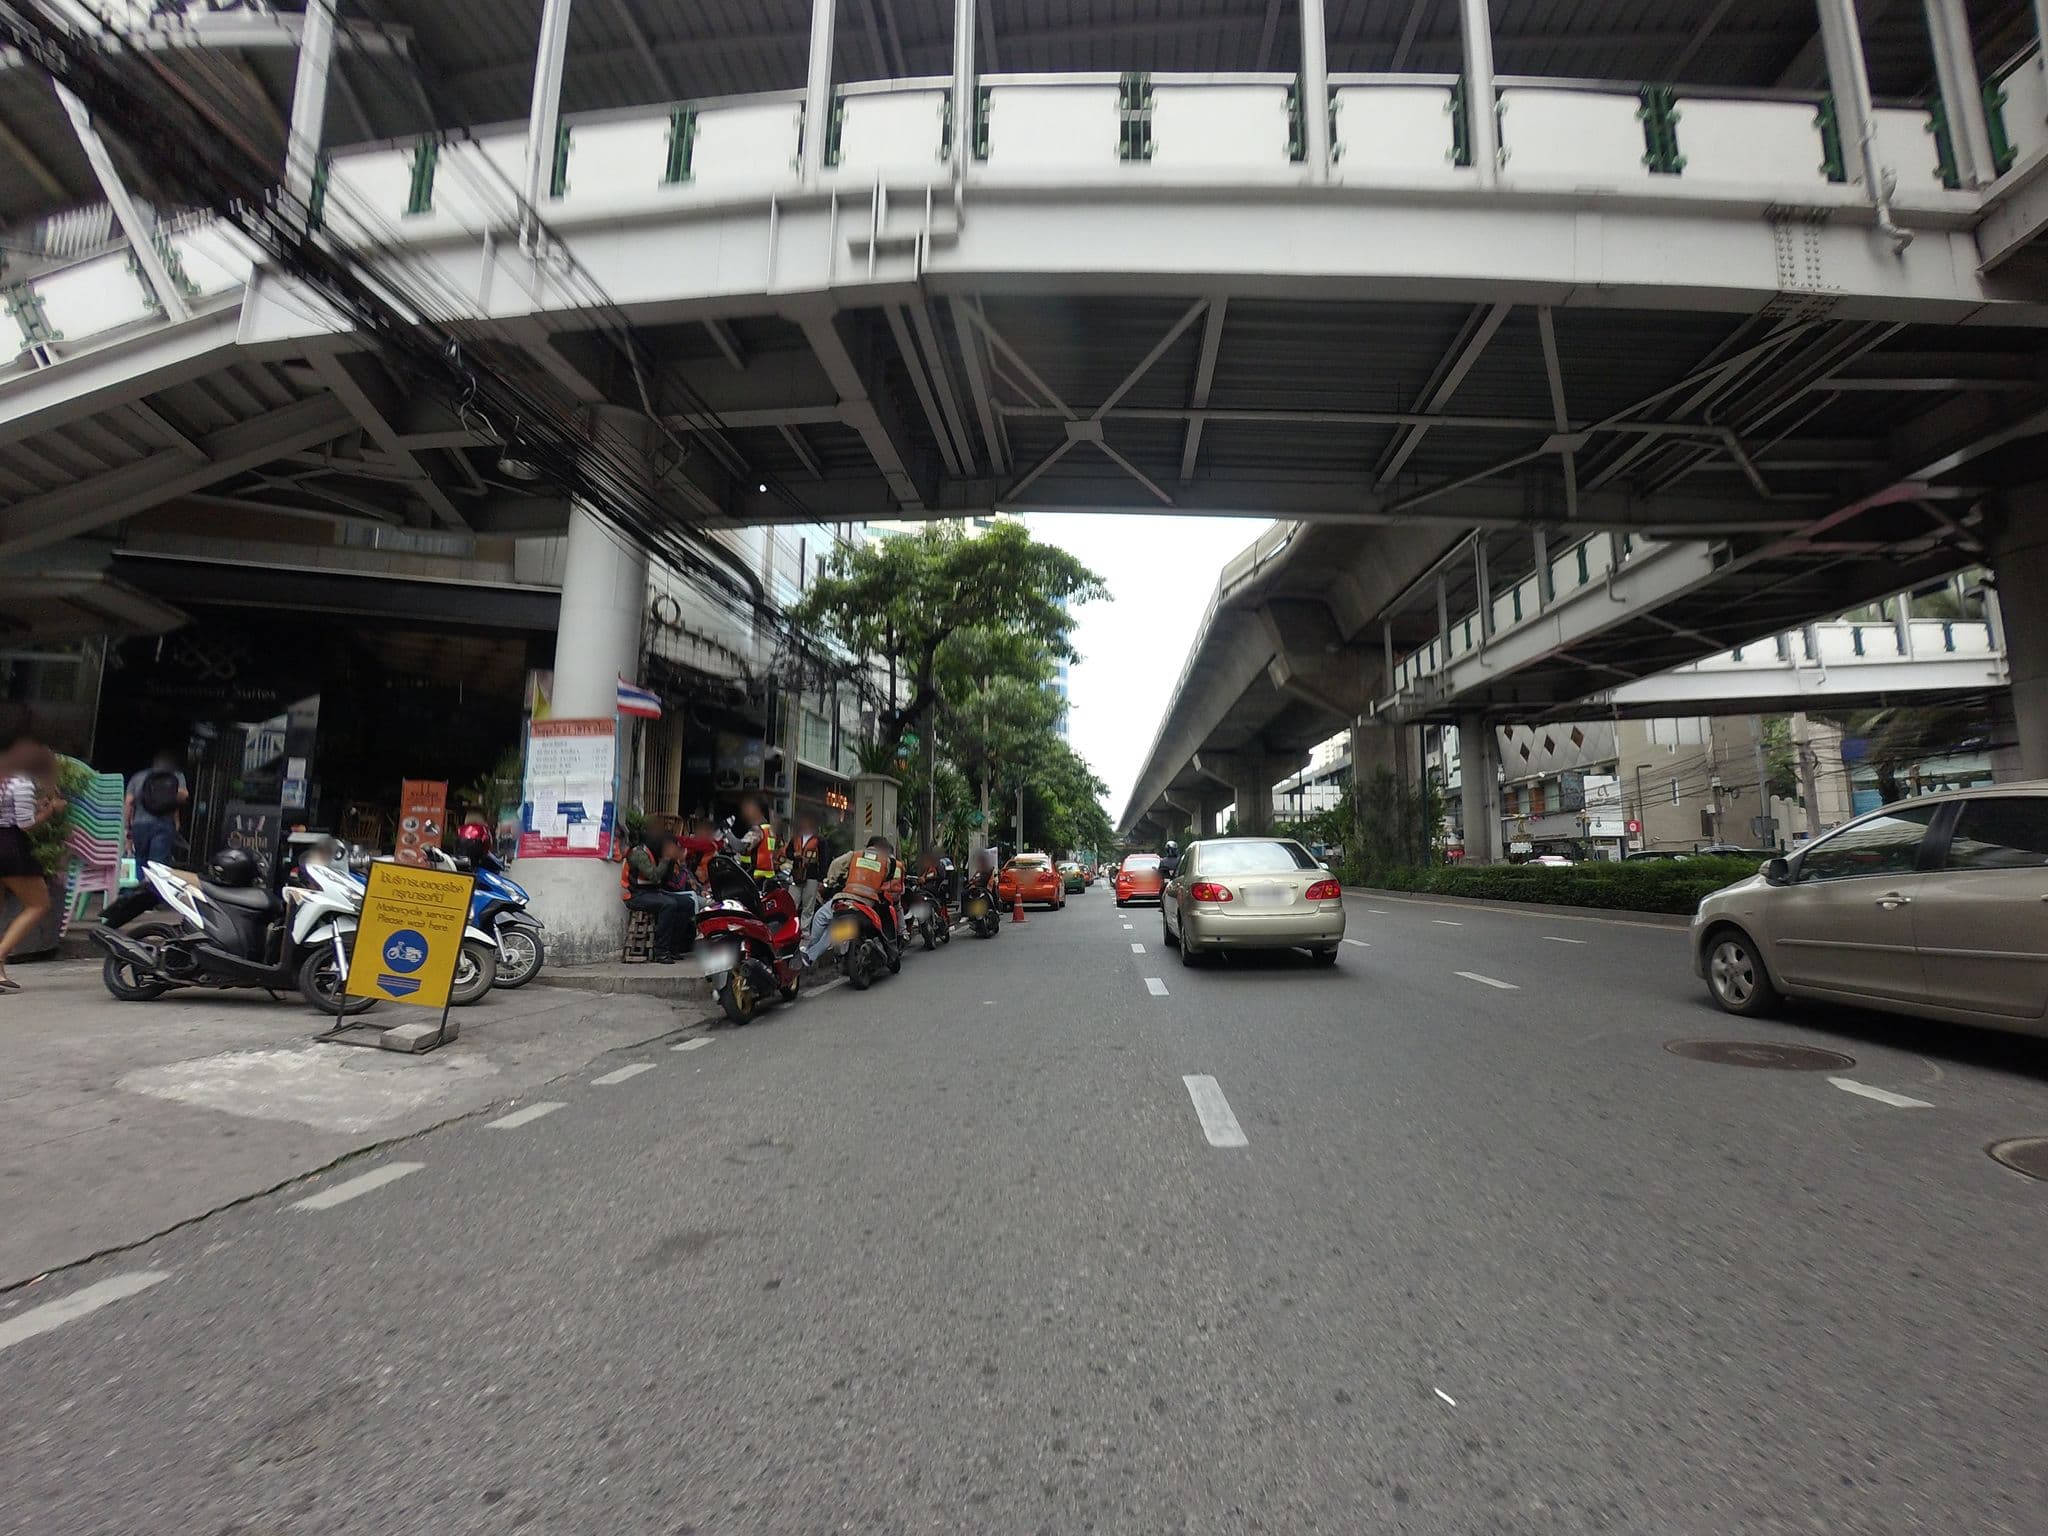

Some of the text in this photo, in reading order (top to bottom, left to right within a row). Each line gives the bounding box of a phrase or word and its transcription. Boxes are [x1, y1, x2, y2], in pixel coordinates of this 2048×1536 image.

[376, 903, 456, 922] Motorcycle service
[377, 913, 404, 925] Please
[407, 919, 426, 928] wait
